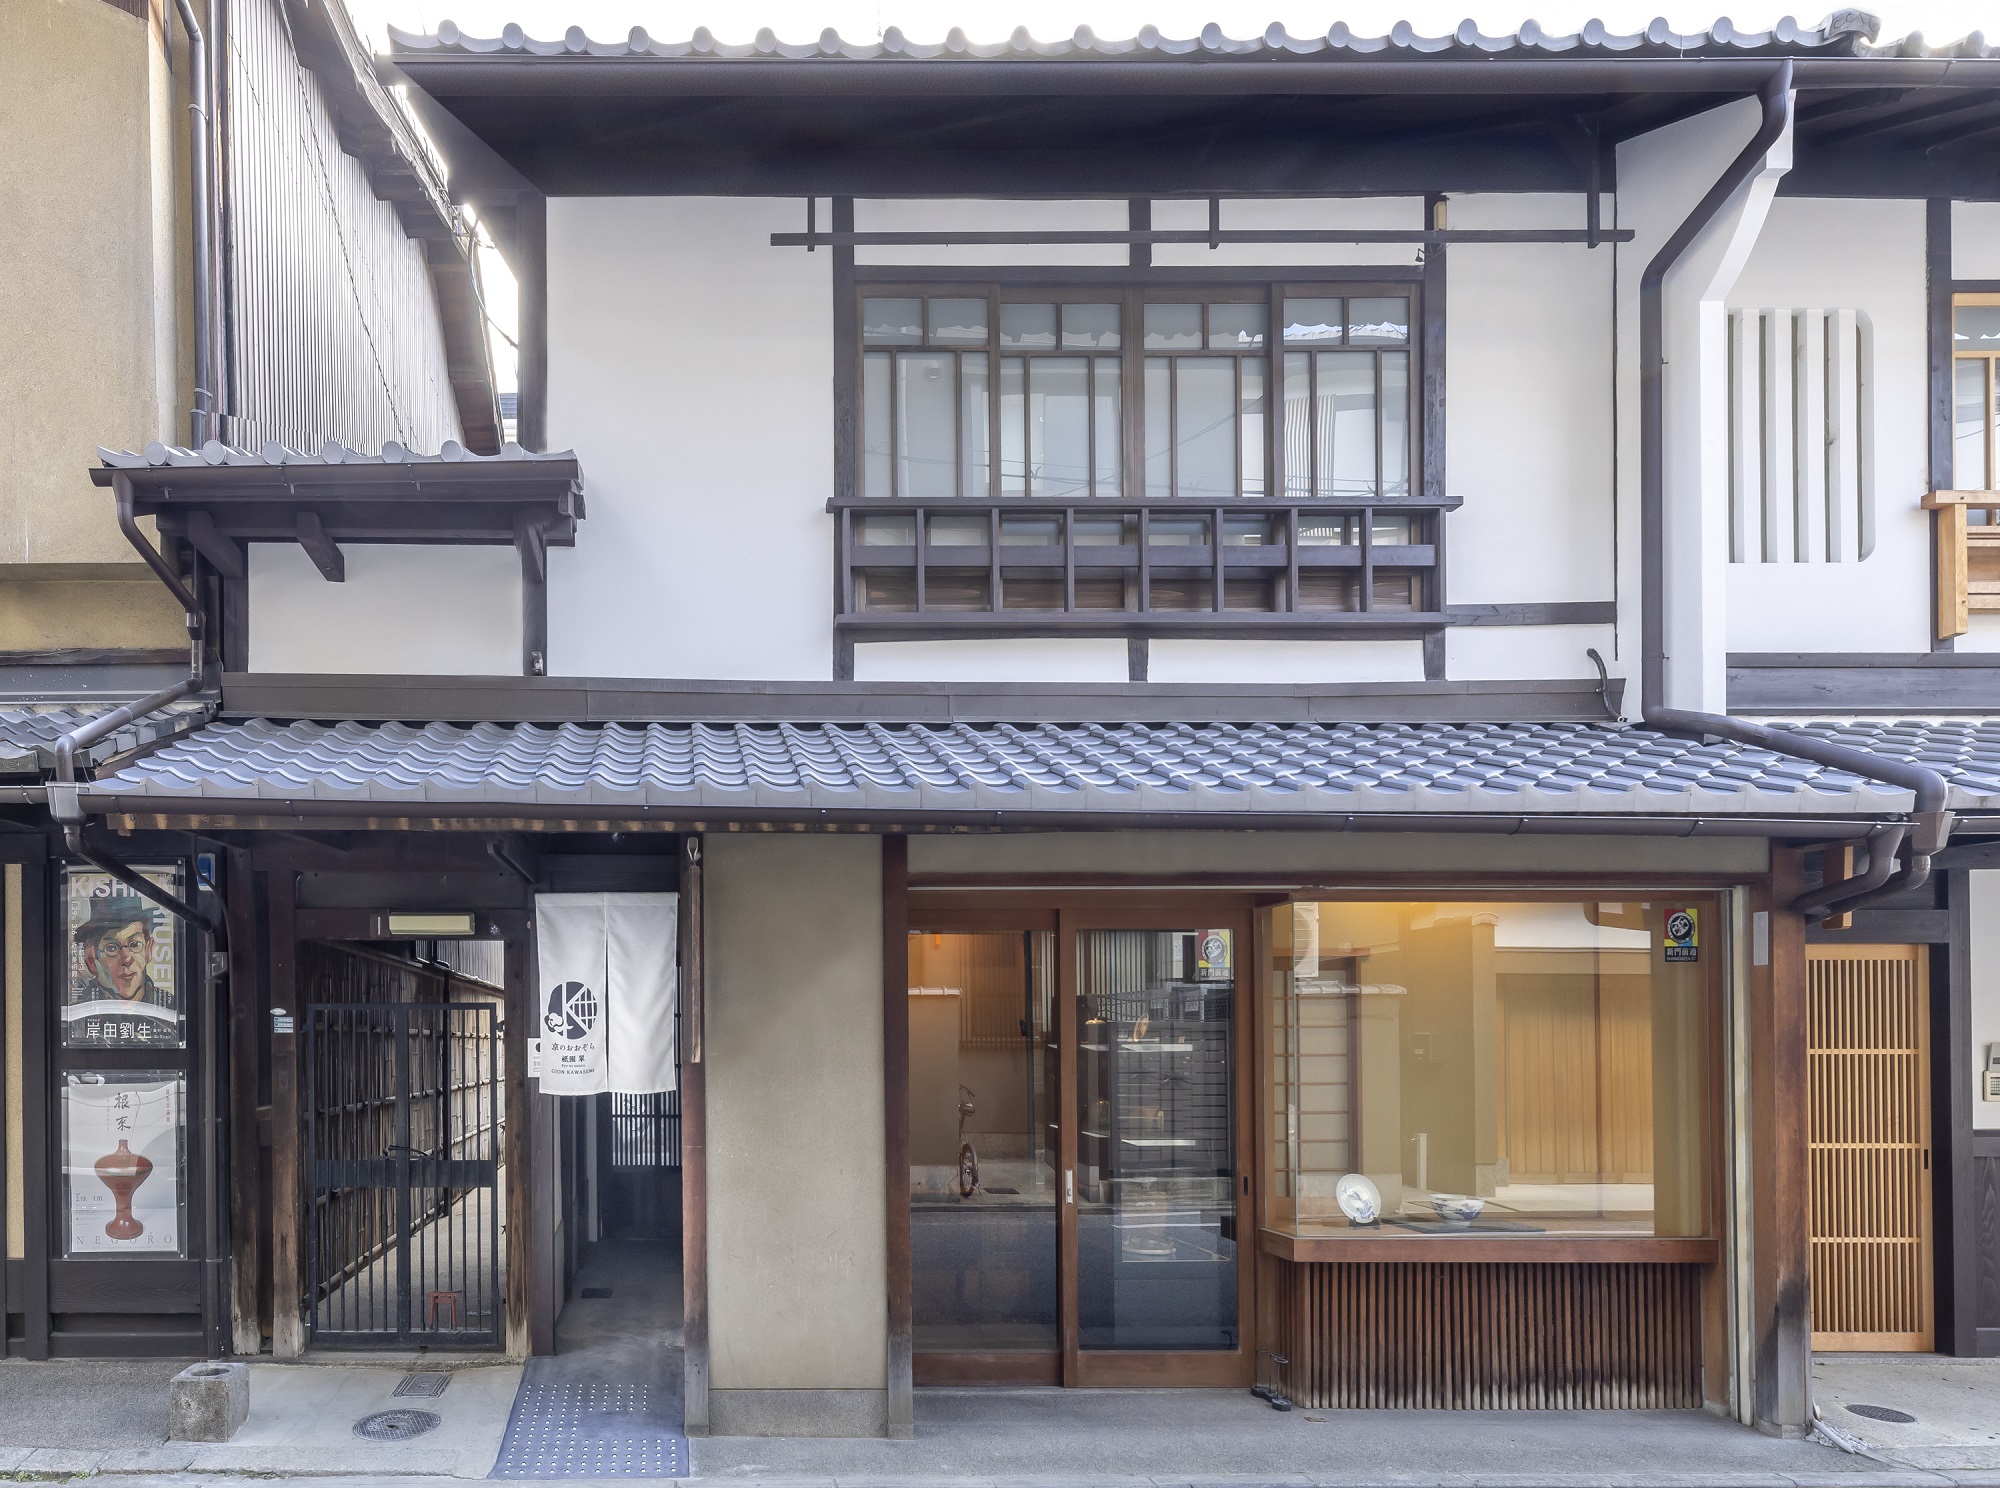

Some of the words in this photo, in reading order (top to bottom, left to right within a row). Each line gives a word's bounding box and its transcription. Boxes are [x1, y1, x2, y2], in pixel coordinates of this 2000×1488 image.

[86, 1021, 152, 1039] 岸田劉生
[551, 1042, 595, 1052] 京のおおぞら
